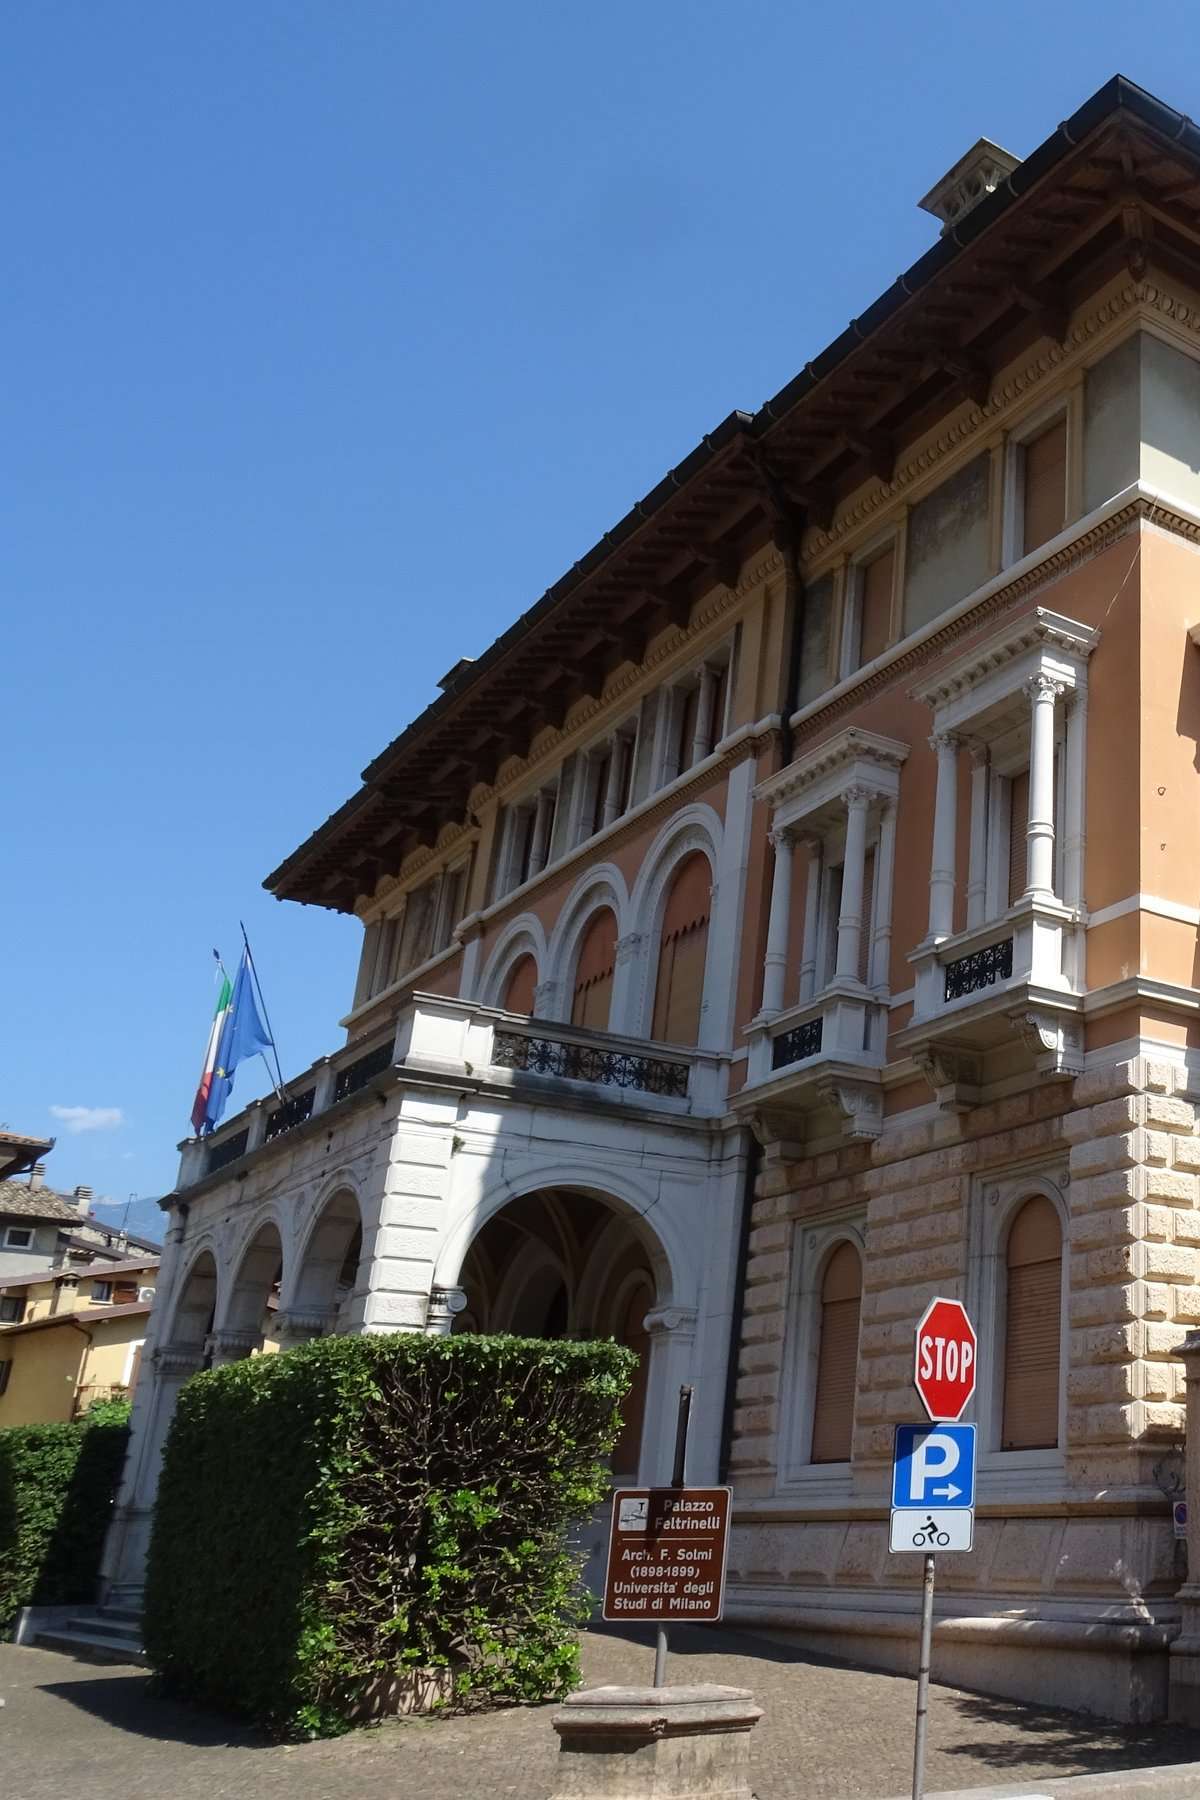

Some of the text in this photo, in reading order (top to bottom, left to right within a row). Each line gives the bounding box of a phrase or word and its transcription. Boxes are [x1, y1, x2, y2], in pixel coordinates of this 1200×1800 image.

[920, 1335, 973, 1384] STOP
[909, 1433, 961, 1501] P
[664, 1499, 714, 1512] Palazzo
[655, 1516, 720, 1530] Feltrinelli
[621, 1548, 712, 1561] Arch. F. Solmi
[630, 1565, 700, 1578] (1898-1899)
[683, 1581, 714, 1596] degli
[613, 1598, 711, 1610] Studi di Milano
